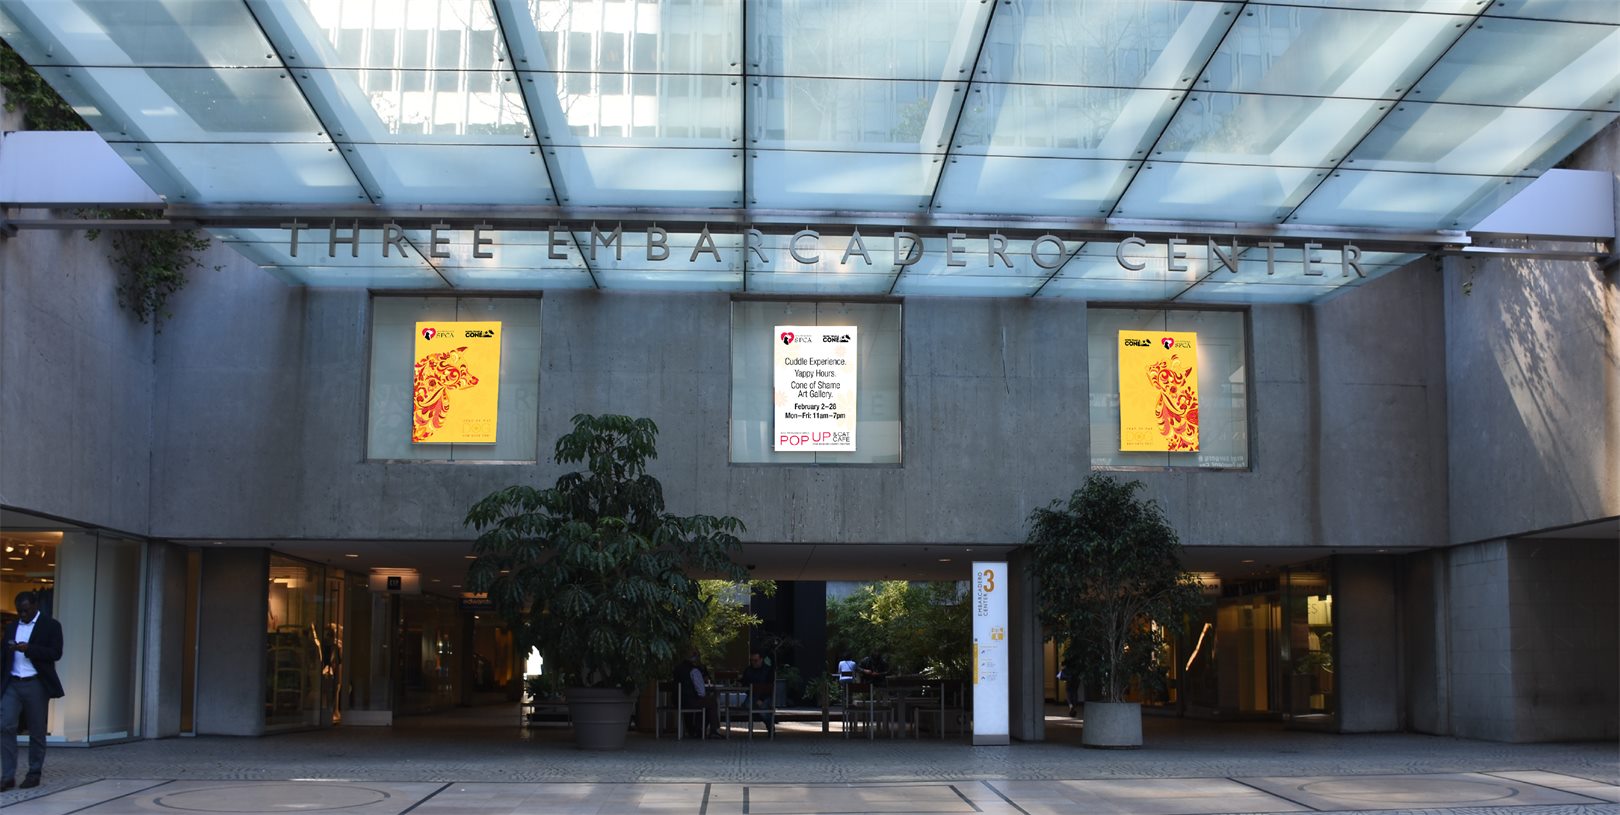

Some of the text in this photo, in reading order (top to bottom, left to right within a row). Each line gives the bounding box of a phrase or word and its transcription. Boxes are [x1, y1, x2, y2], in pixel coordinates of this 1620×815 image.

[281, 222, 1367, 279] THREE EMBARCADERO CENTER
[784, 357, 847, 367] Cuddle Experience.
[794, 369, 836, 378] Yappy Hours.
[790, 380, 841, 389] Cone of Shame
[797, 389, 834, 399] Art Gallery.
[794, 403, 820, 411] February
[780, 431, 831, 446] POP UP
[983, 570, 994, 592] 3
